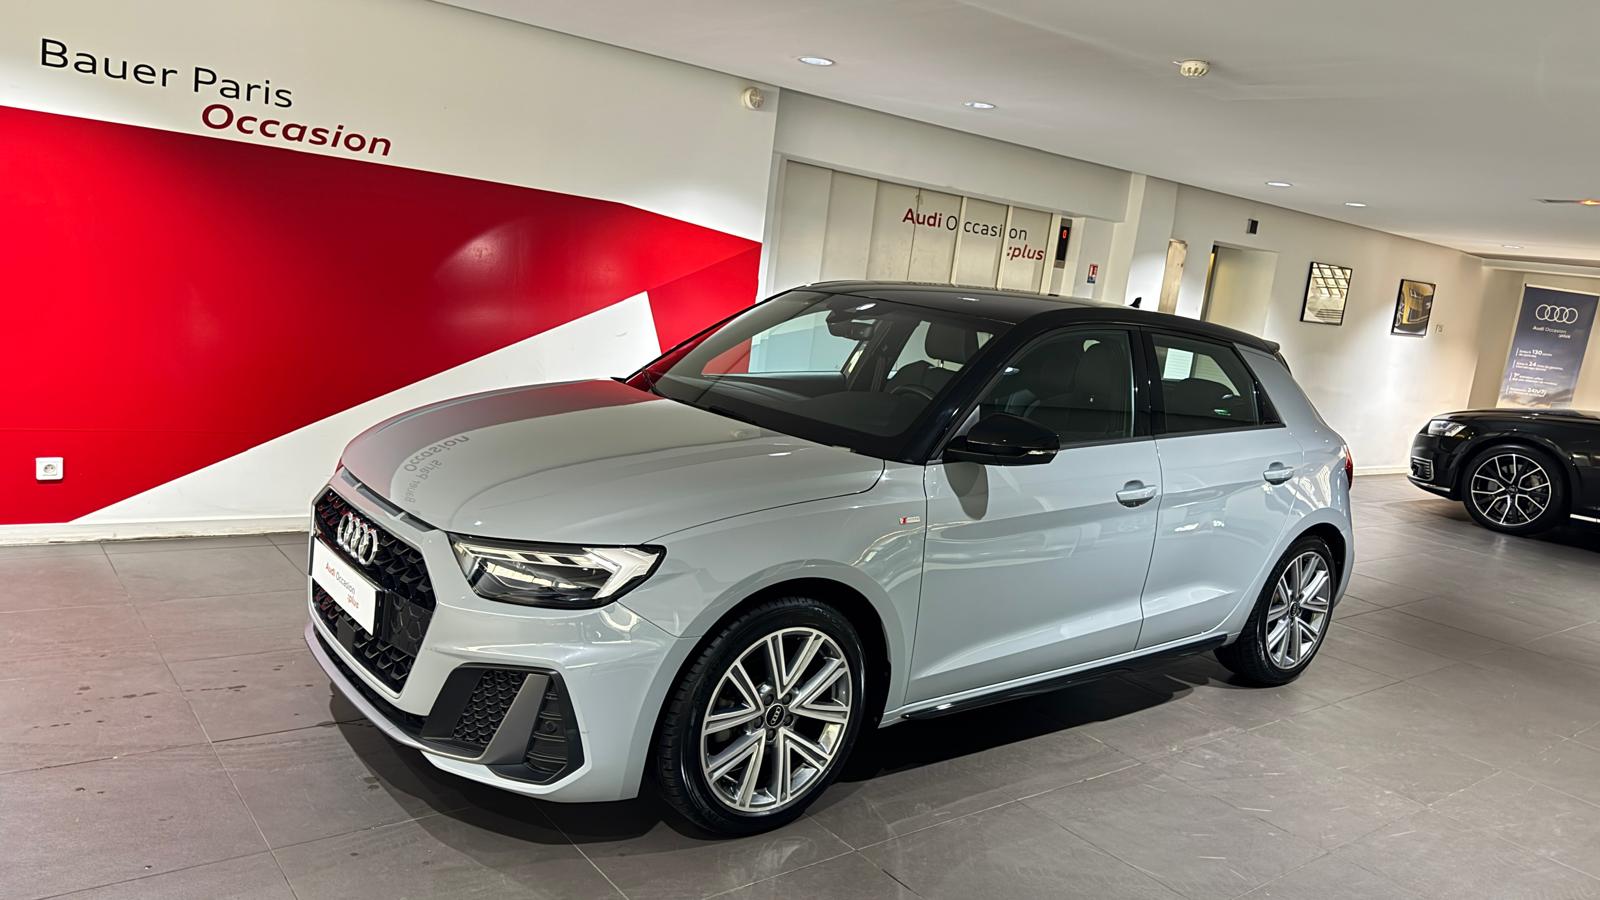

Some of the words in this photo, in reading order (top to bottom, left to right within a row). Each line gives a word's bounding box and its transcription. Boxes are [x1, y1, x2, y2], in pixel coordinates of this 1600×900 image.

[40, 37, 178, 88] Bauer
[193, 66, 293, 109] Paris
[201, 103, 392, 157] Occasion
[902, 207, 943, 228] Audi
[946, 215, 1028, 241] Occasion
[1006, 245, 1045, 262] :plus
